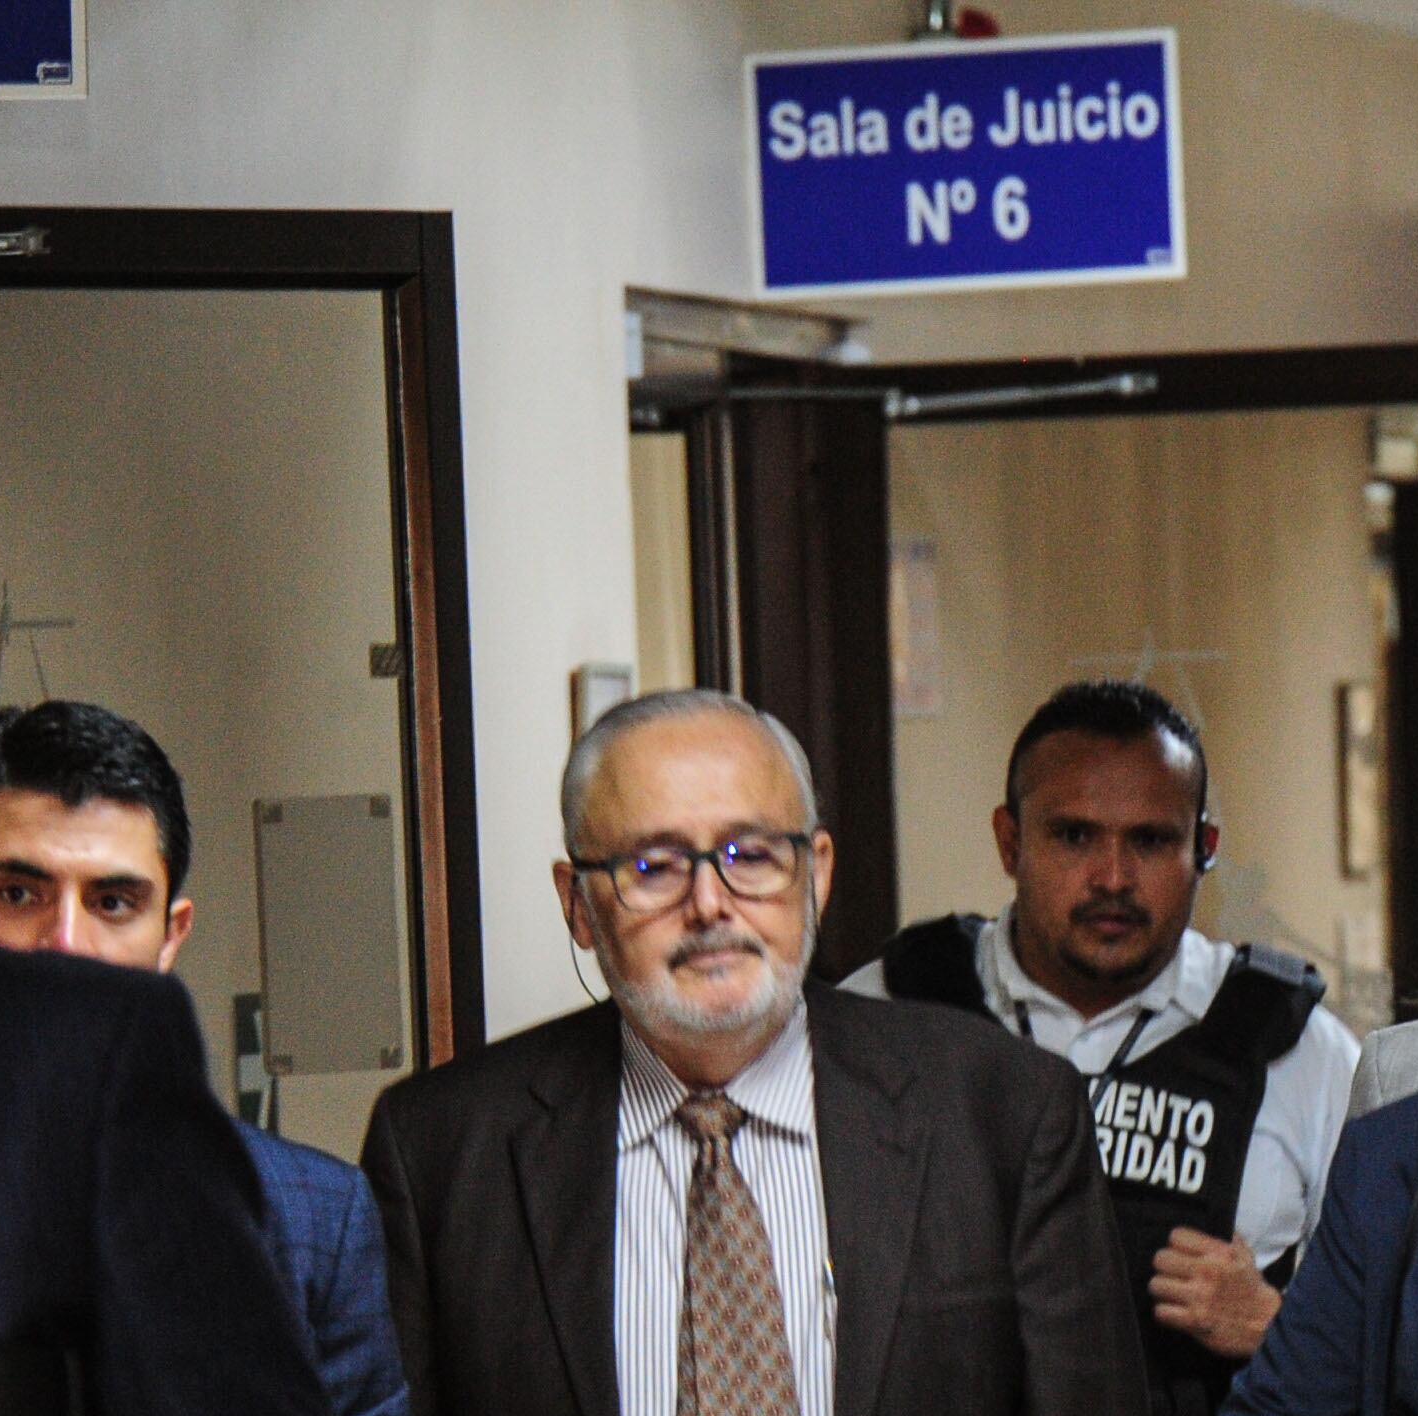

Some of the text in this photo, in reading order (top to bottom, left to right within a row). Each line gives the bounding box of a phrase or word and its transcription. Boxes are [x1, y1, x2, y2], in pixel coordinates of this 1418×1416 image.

[768, 80, 1160, 161] Sala de Juicio
[992, 174, 1031, 241] 6
